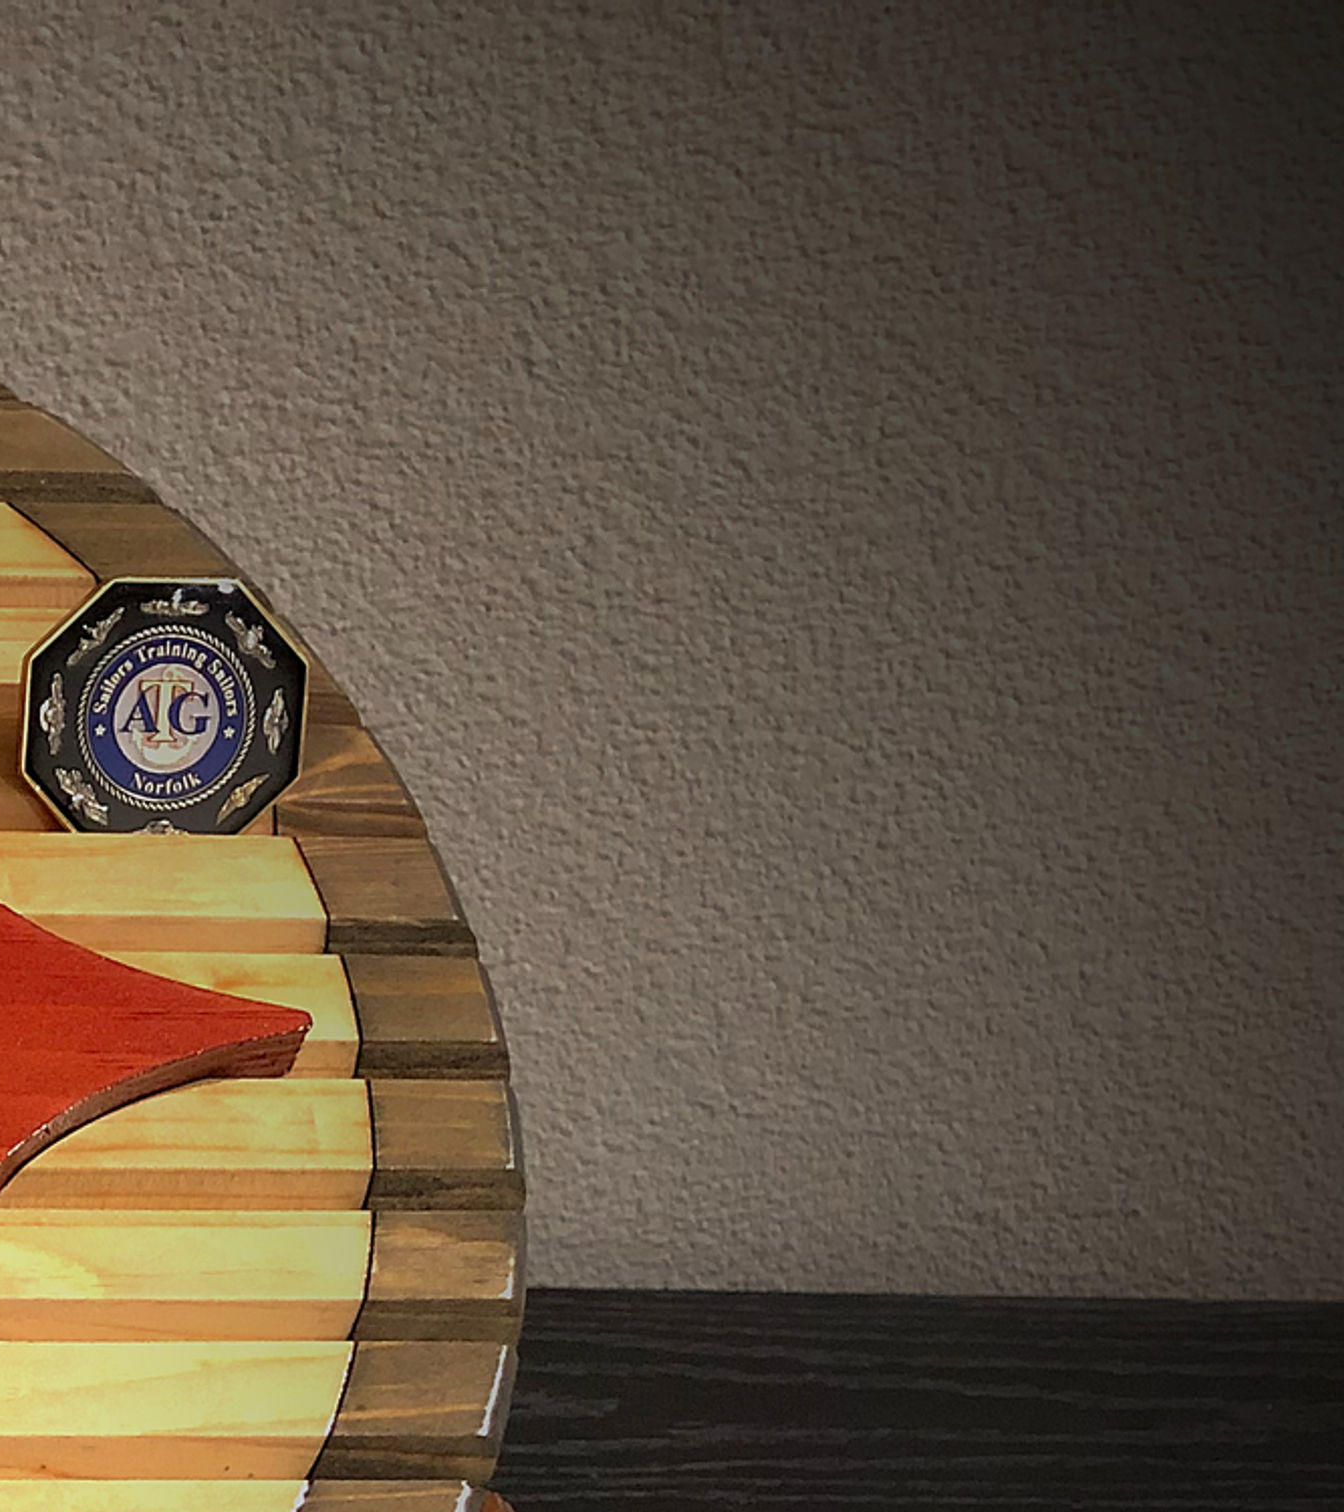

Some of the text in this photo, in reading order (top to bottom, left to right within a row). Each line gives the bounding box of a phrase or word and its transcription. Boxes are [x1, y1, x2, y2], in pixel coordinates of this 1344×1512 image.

[92, 640, 238, 717] Sailors Training Sailors
[130, 772, 203, 796] Norfolk
